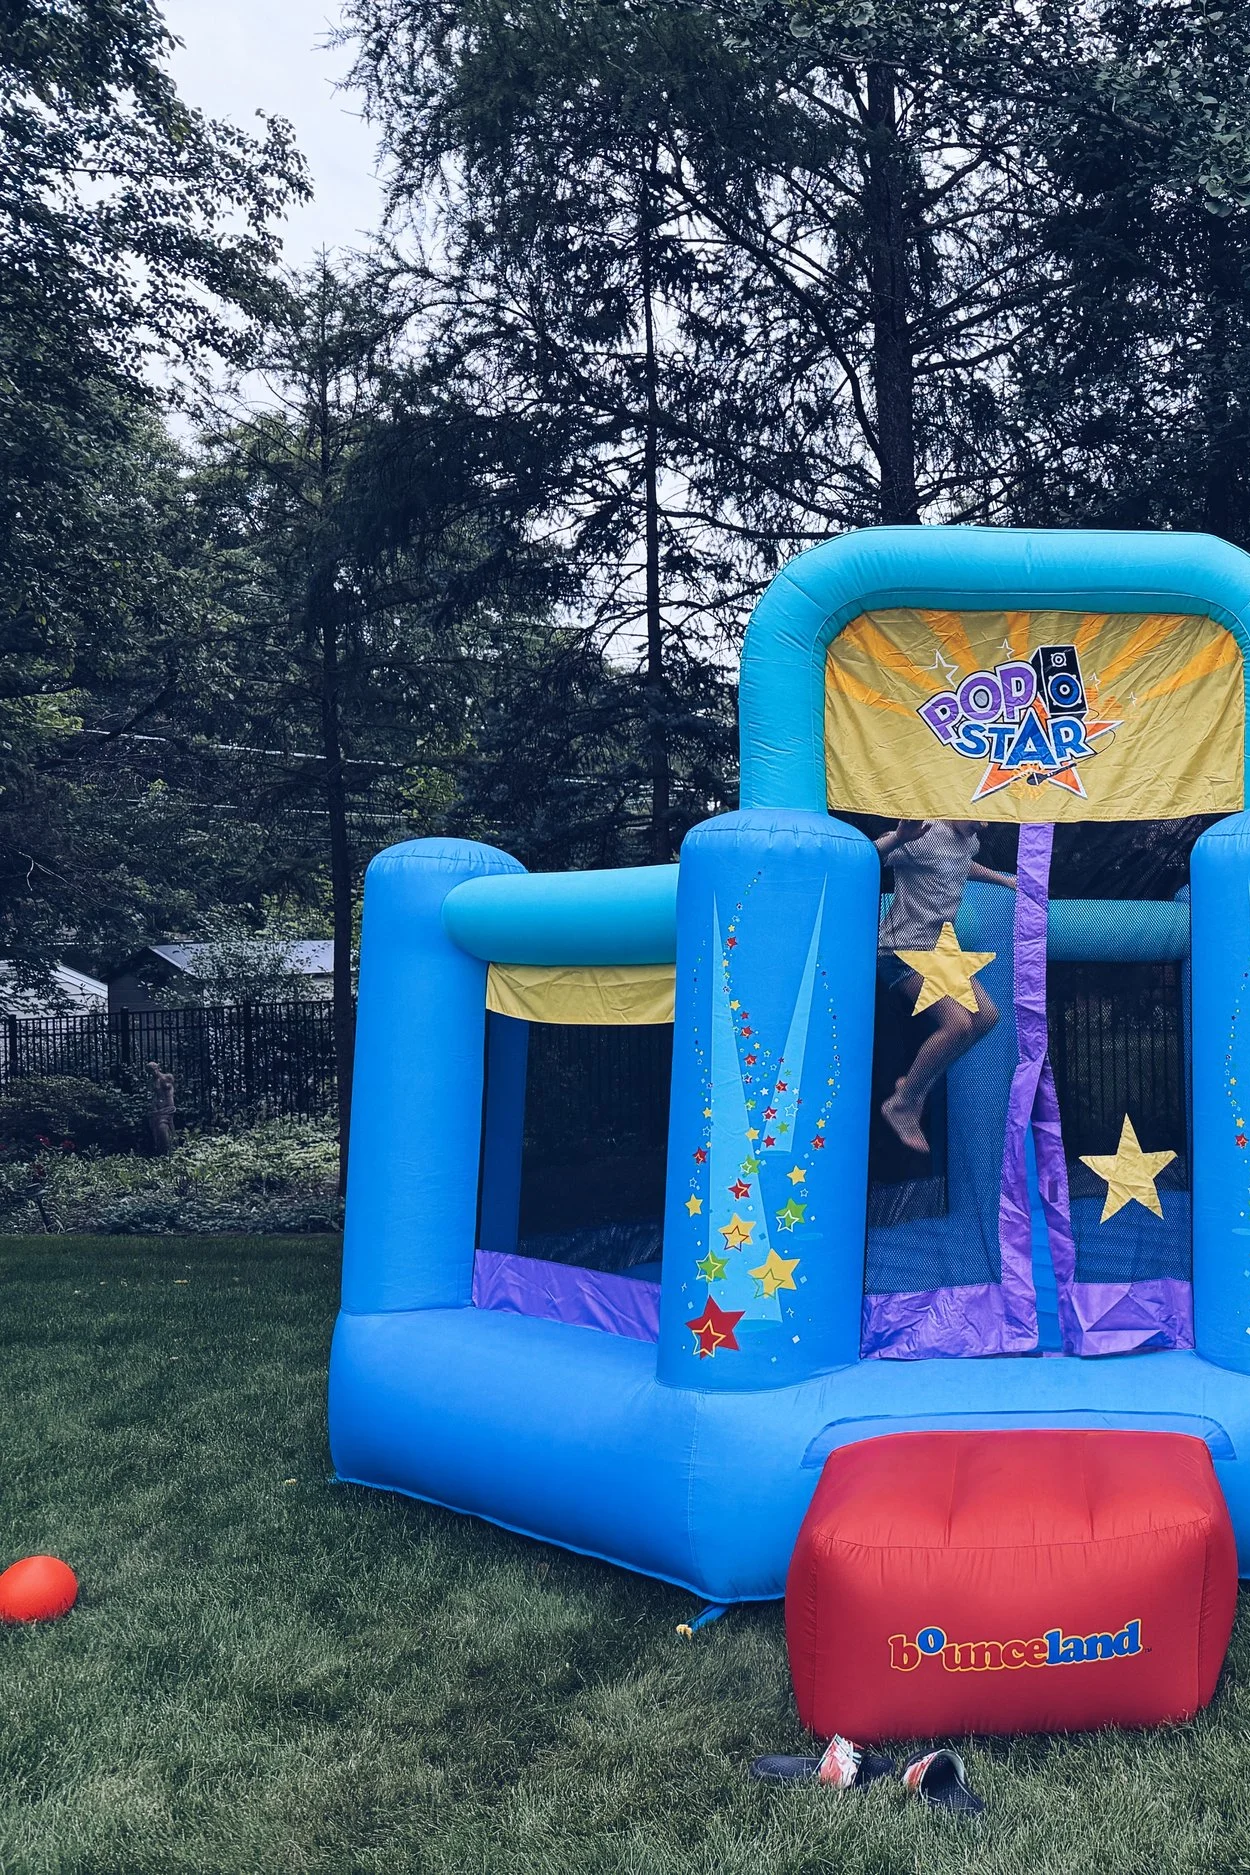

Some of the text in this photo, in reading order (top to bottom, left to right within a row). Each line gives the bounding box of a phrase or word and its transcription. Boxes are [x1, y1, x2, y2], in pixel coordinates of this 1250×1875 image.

[917, 661, 1037, 746] POP
[952, 707, 1097, 769] STAR
[888, 1618, 1143, 1671] bounceland
